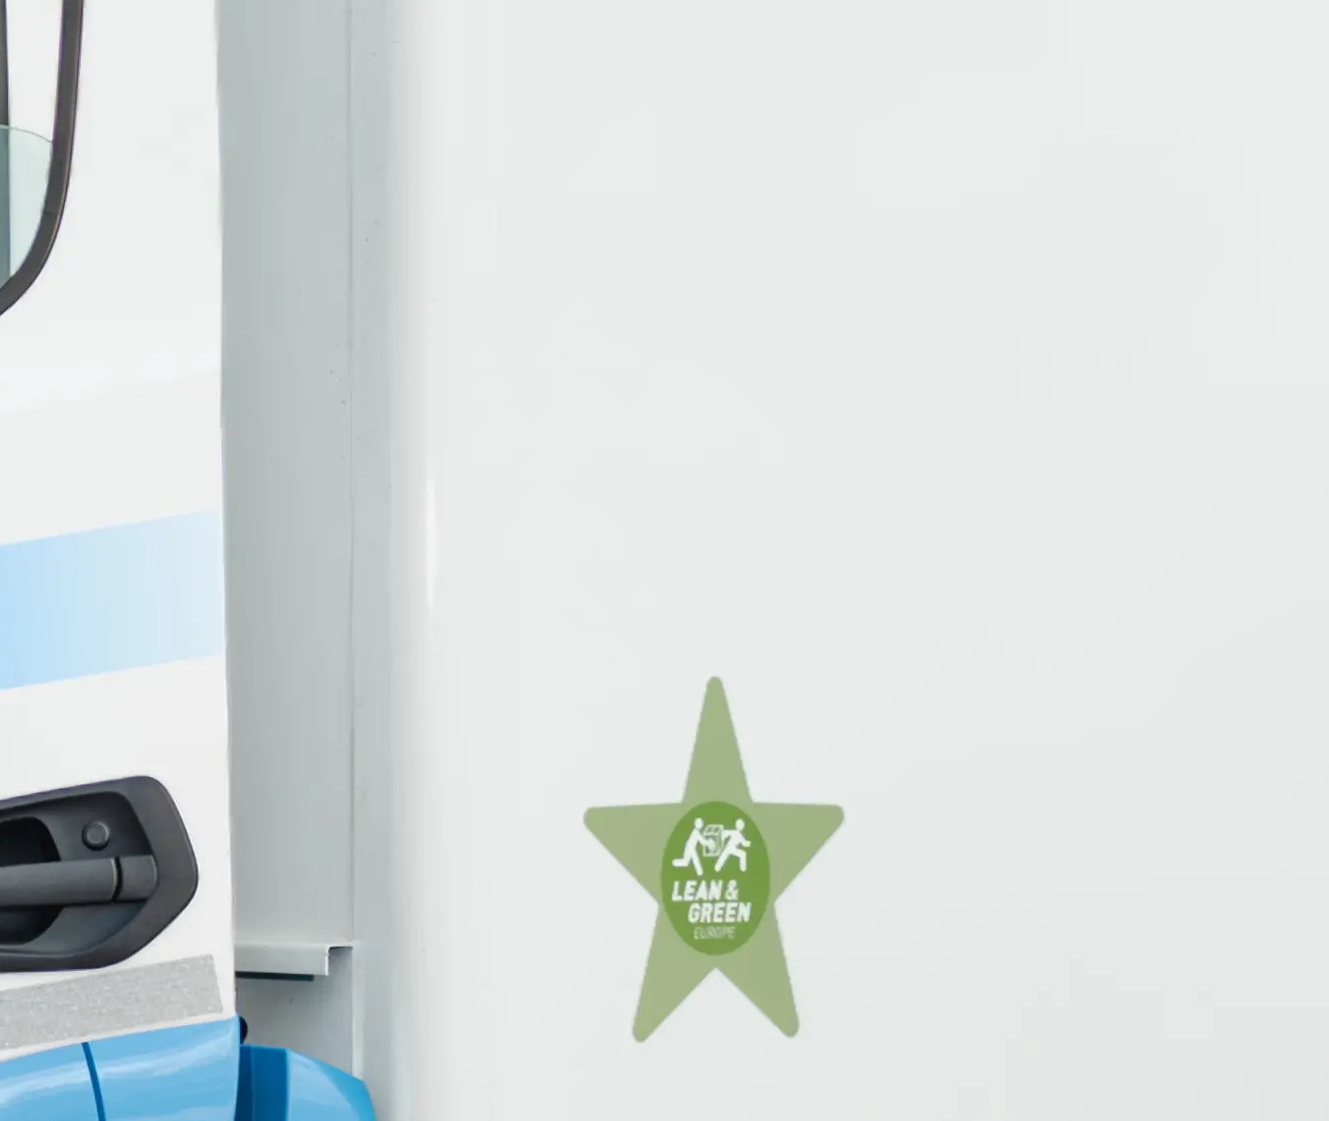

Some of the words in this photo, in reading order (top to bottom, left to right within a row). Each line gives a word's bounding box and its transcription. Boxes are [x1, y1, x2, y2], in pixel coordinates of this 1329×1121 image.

[671, 880, 723, 901] LEAN
[725, 880, 739, 900] &
[687, 902, 752, 923] GREEN
